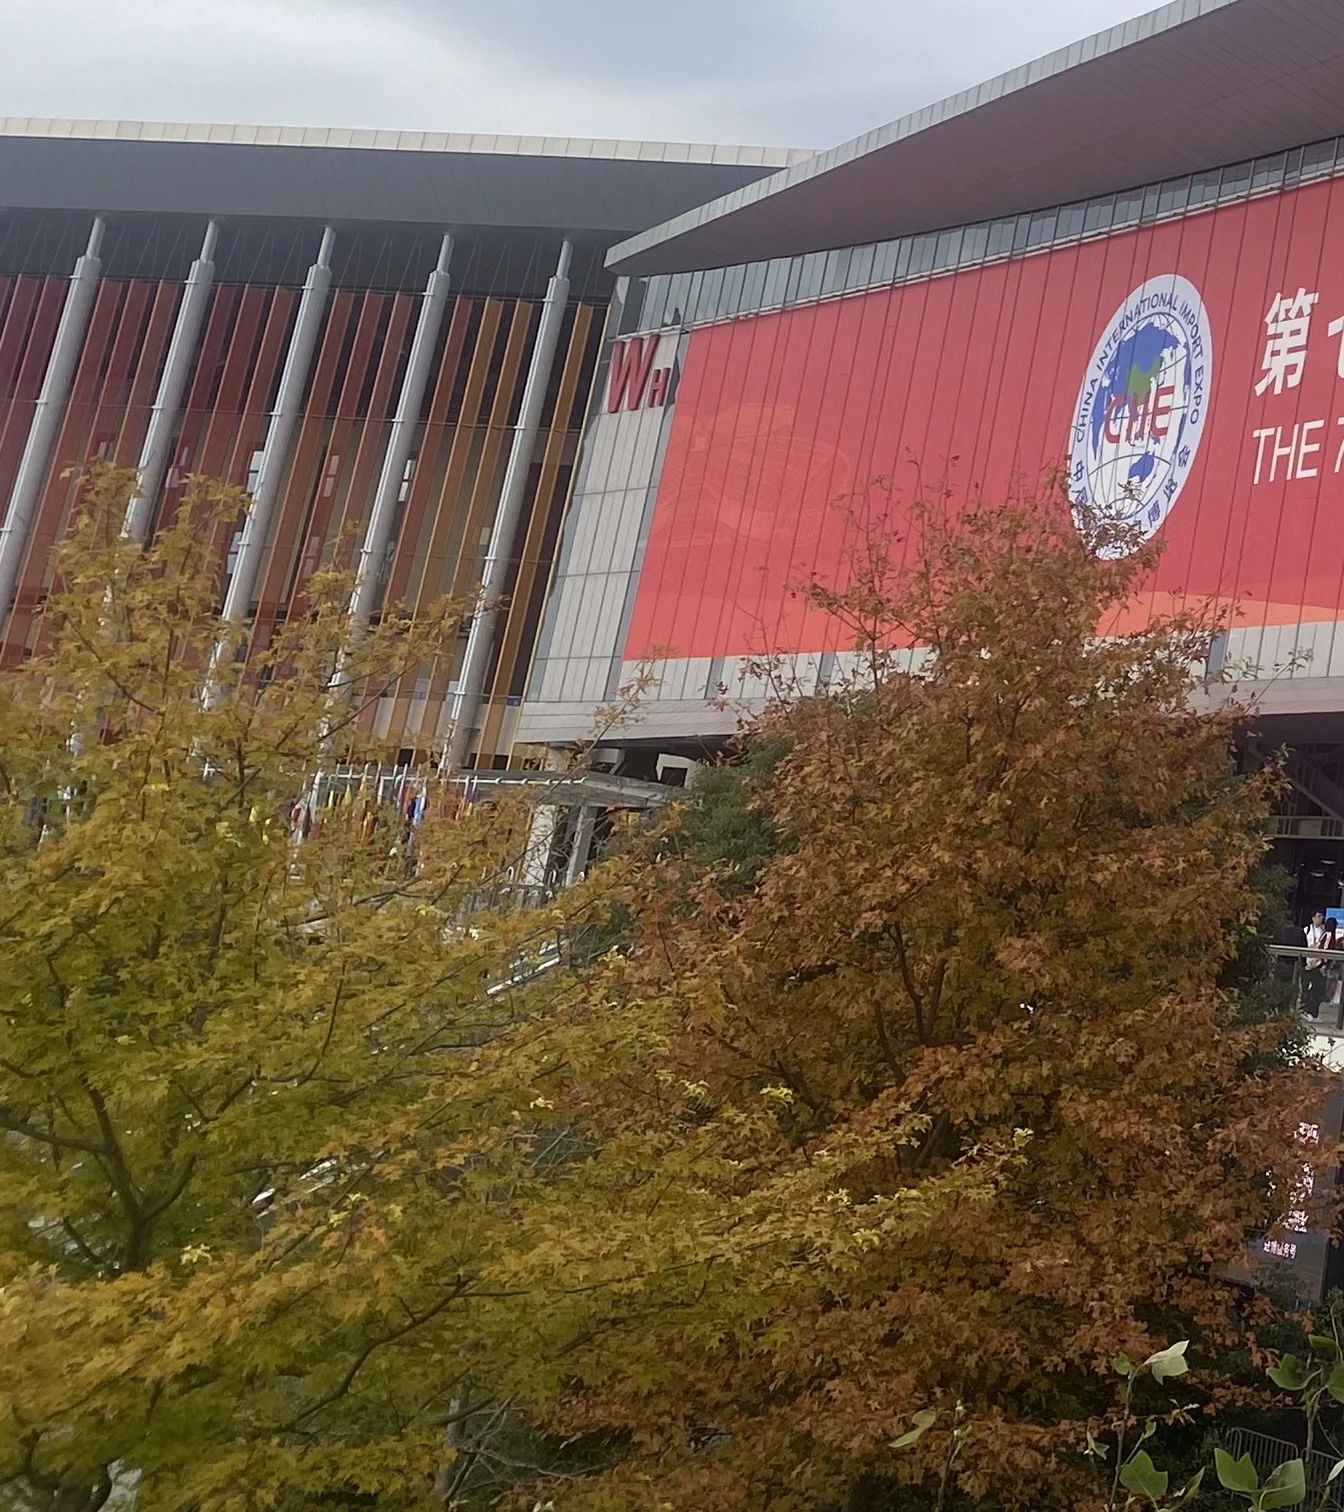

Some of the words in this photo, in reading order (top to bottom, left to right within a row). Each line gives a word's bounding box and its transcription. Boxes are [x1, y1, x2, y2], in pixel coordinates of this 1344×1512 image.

[1096, 292, 1180, 374] INTERNATIONAL
[1178, 300, 1204, 360] IMPORT
[1077, 377, 1099, 443] CHINA
[1188, 364, 1206, 425] EXPO
[1251, 419, 1325, 485] THE
